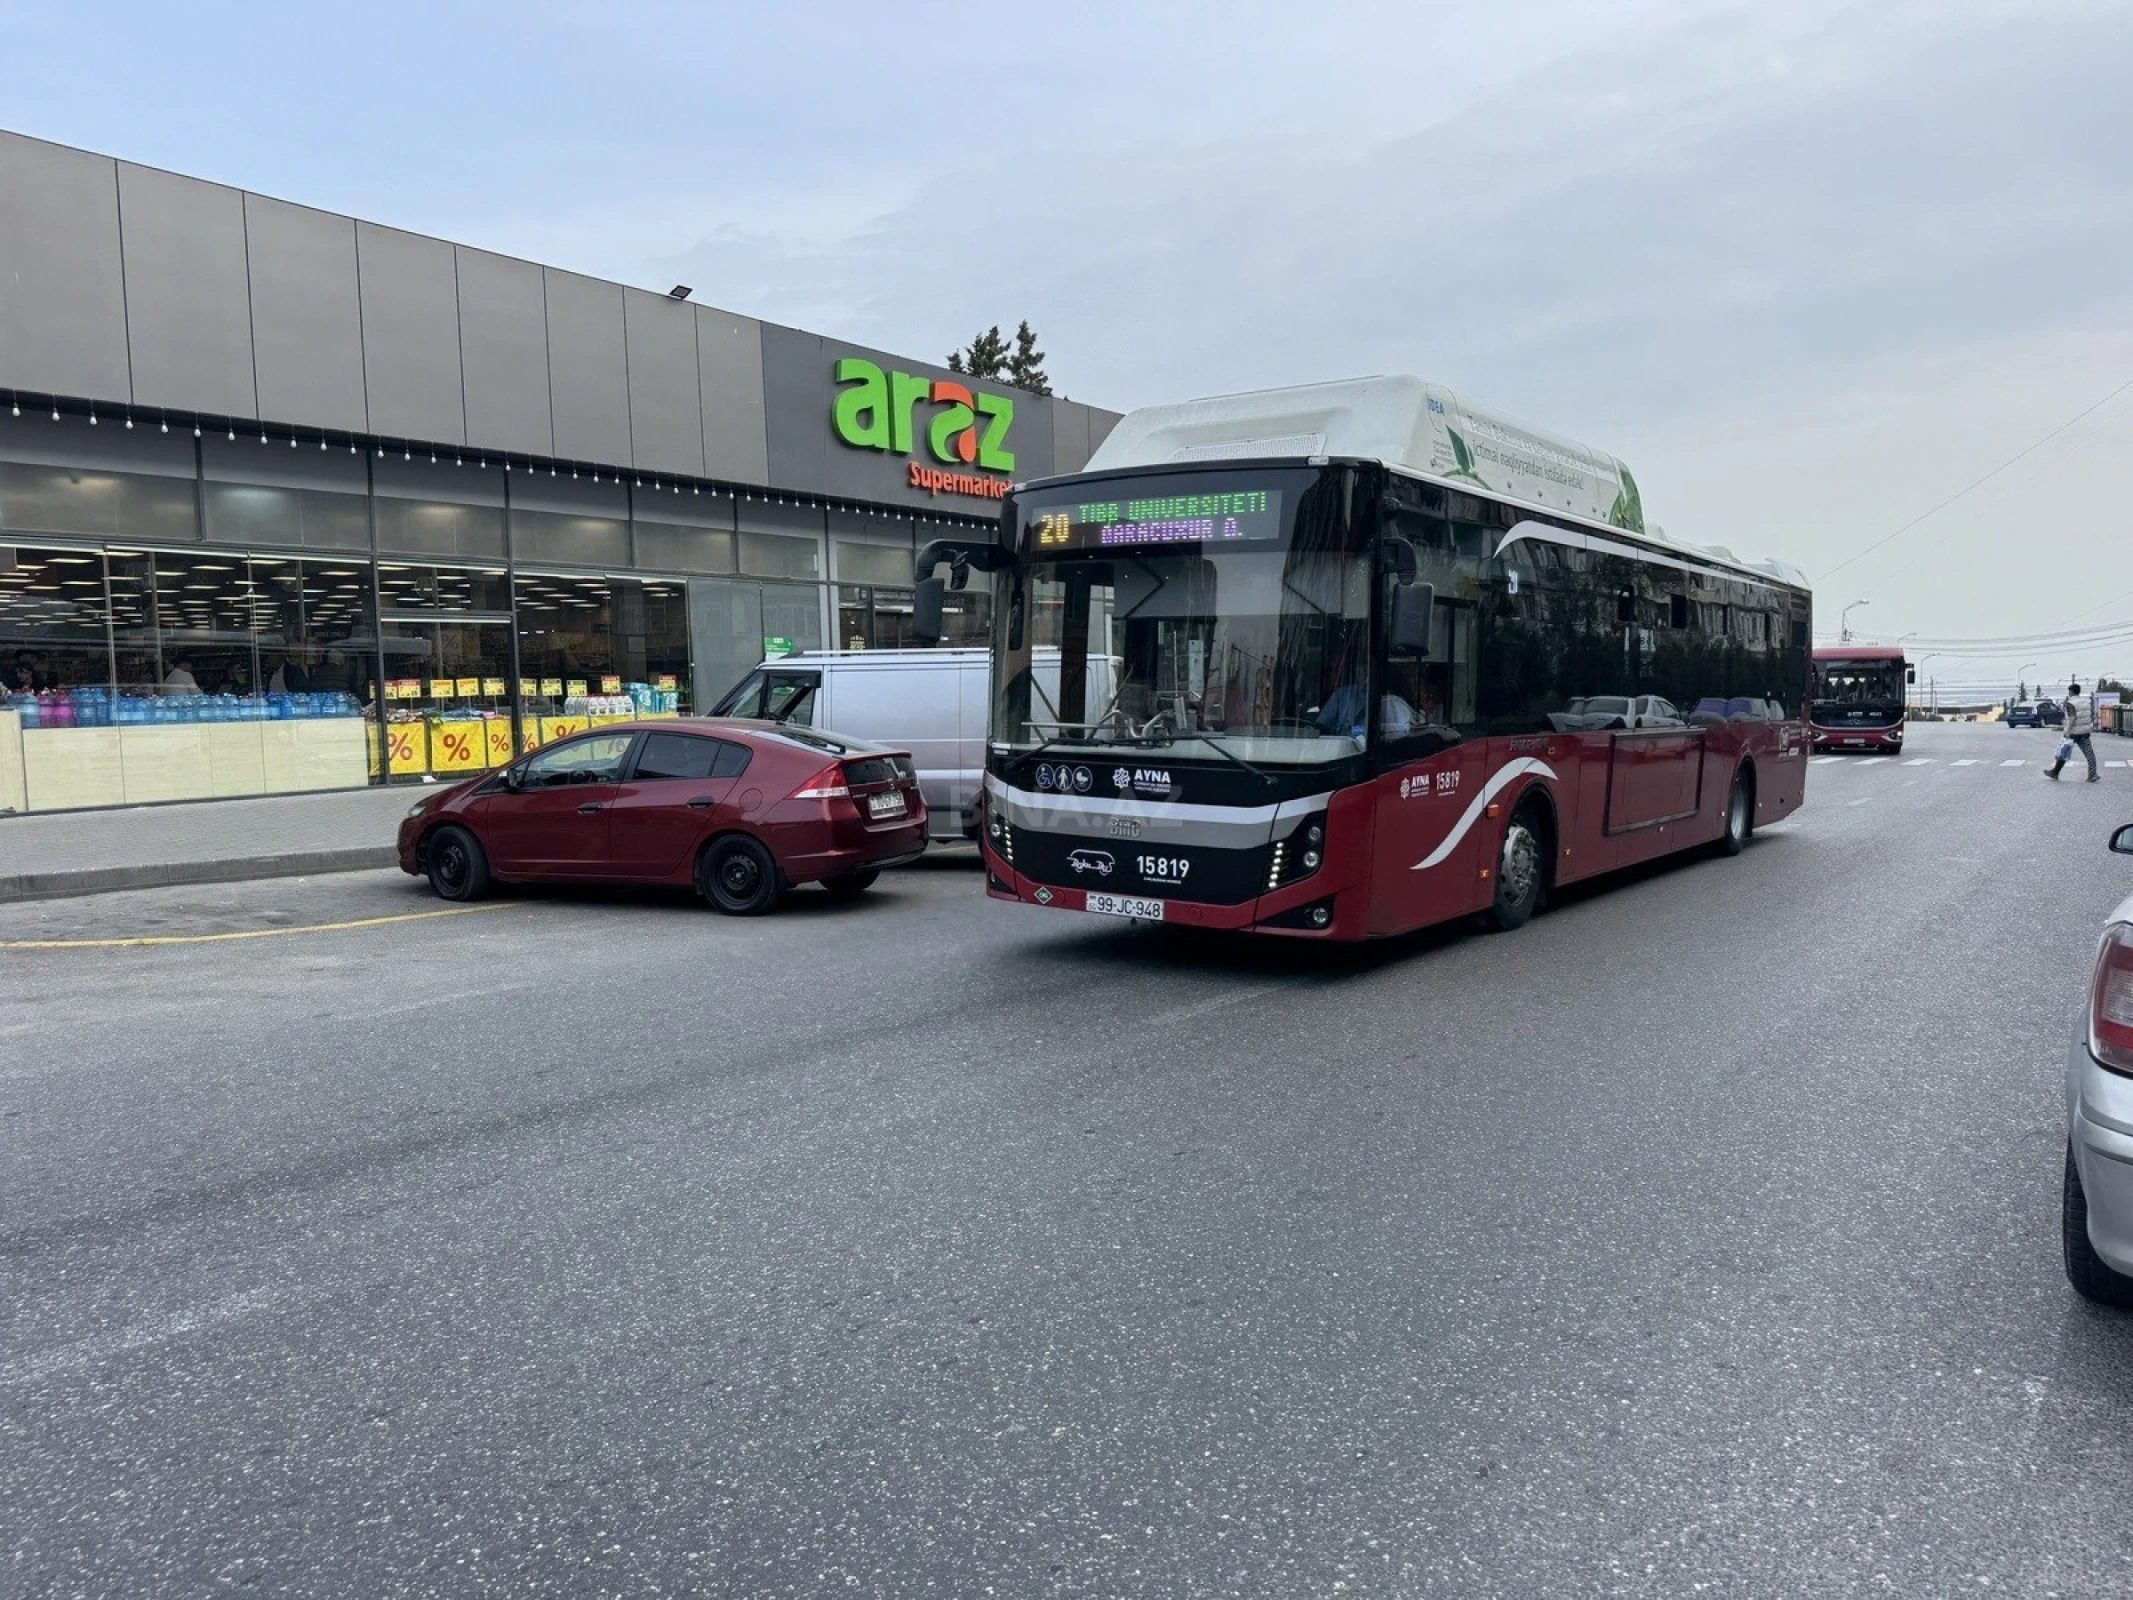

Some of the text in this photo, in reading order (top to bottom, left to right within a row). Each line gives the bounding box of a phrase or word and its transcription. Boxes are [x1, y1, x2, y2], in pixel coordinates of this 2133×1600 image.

[832, 358, 1015, 474] araz
[1040, 514, 1069, 544] 20
[1134, 769, 1171, 783] AYNA
[1412, 770, 1460, 790] AYNA 15819
[1136, 855, 1190, 878] 15819
[1098, 896, 1160, 917] 99-JC-948
